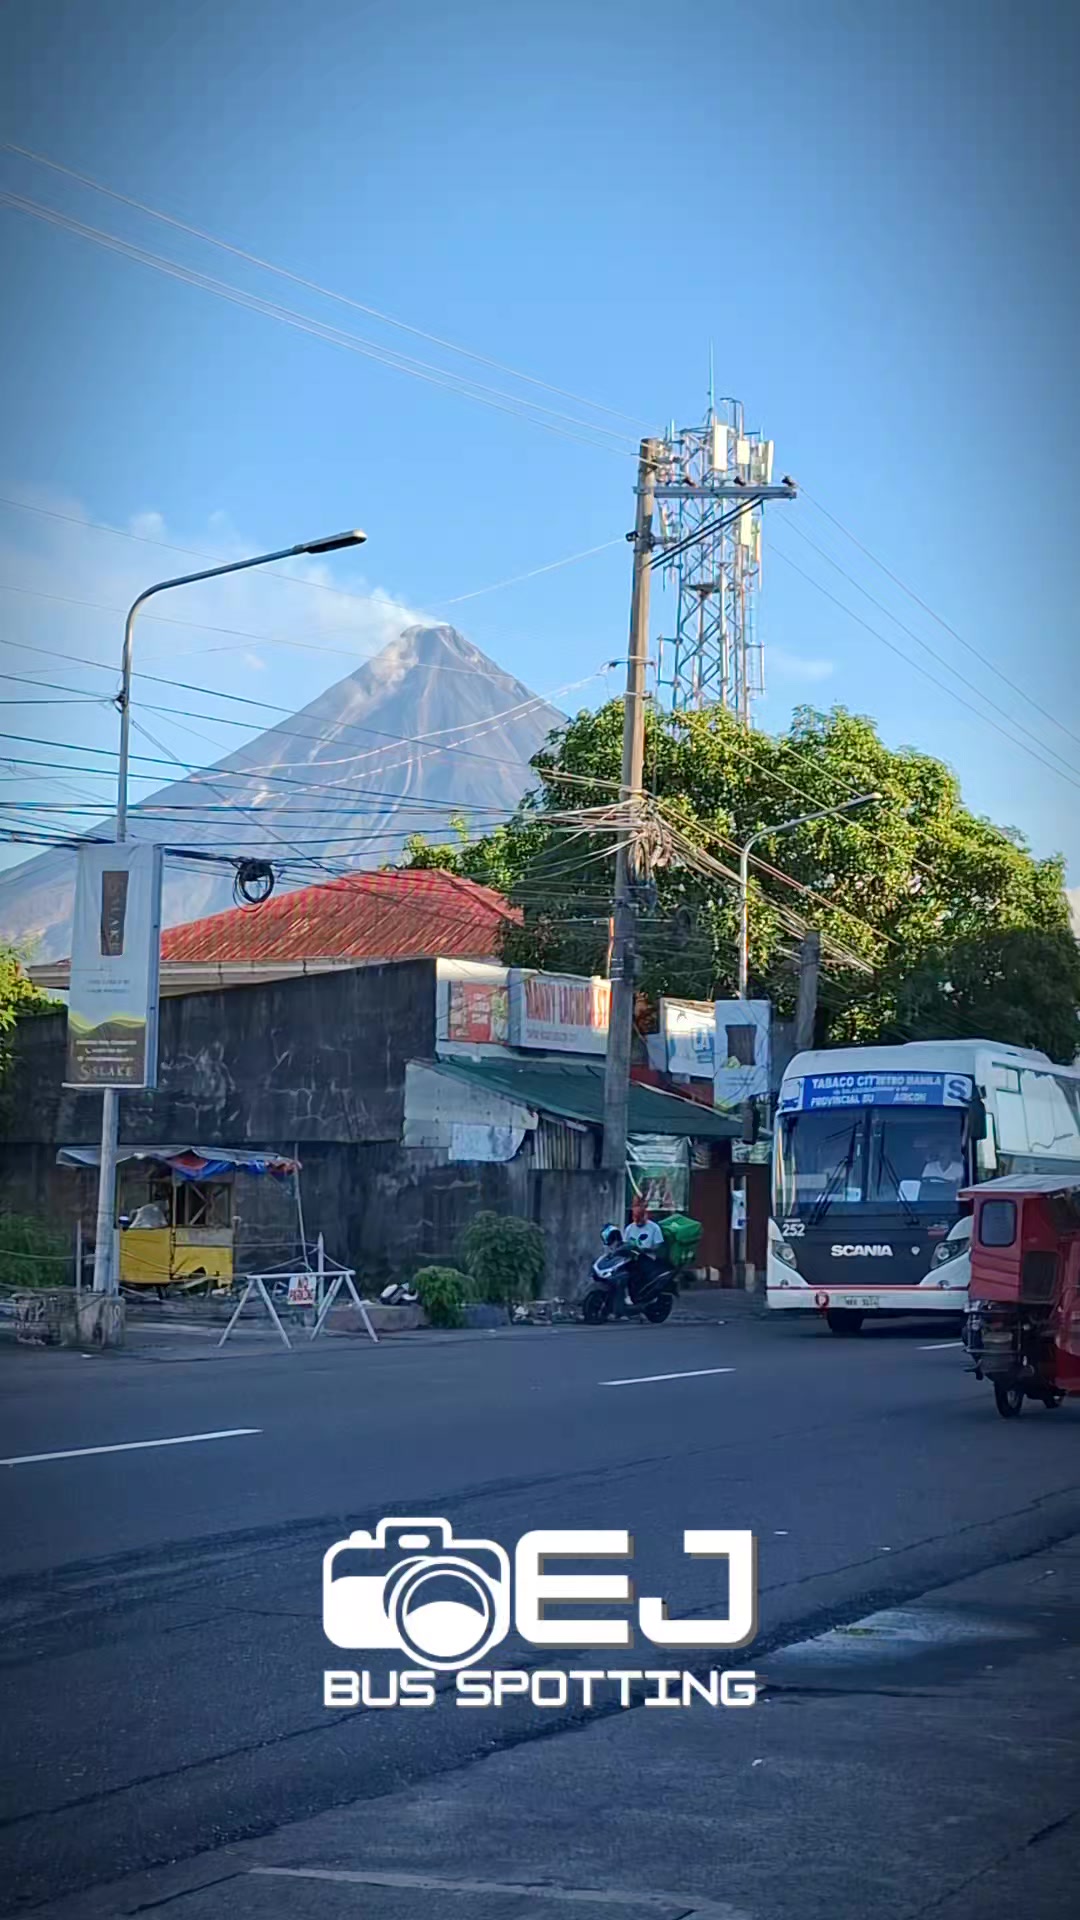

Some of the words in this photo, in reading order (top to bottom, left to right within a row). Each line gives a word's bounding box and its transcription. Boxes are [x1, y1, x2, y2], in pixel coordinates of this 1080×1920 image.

[811, 1076, 855, 1089] TABACO
[907, 1075, 942, 1086] MANILA
[811, 1094, 861, 1108] PROVINCIAL
[782, 1223, 806, 1237] 252
[831, 1244, 894, 1257] SCANIA
